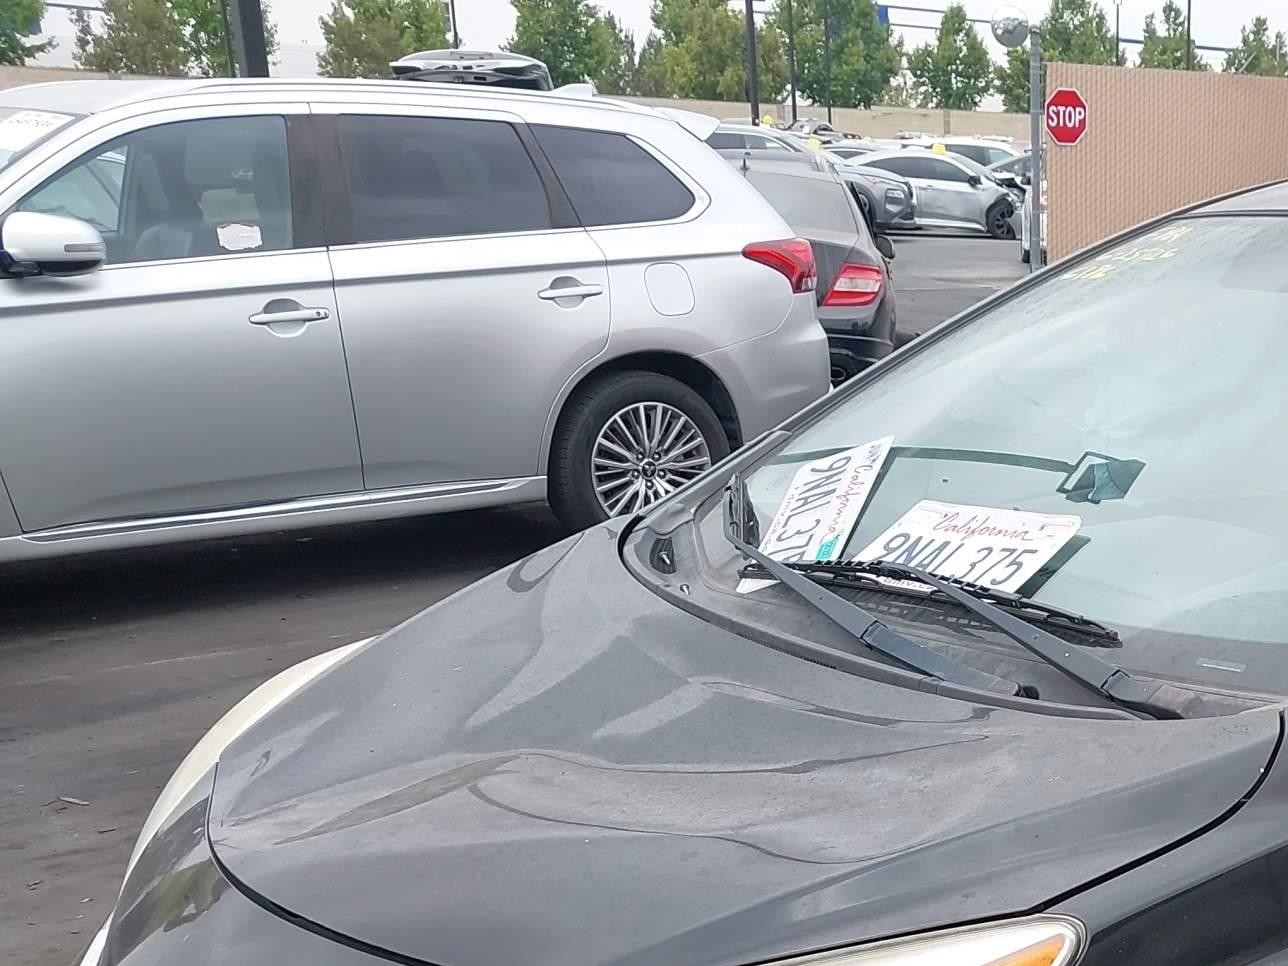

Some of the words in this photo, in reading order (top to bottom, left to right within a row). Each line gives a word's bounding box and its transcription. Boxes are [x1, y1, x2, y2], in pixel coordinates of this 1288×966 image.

[1048, 105, 1085, 128] STOP
[819, 464, 873, 545] California
[932, 511, 1034, 542] California
[872, 532, 1039, 586] 9NAL375
